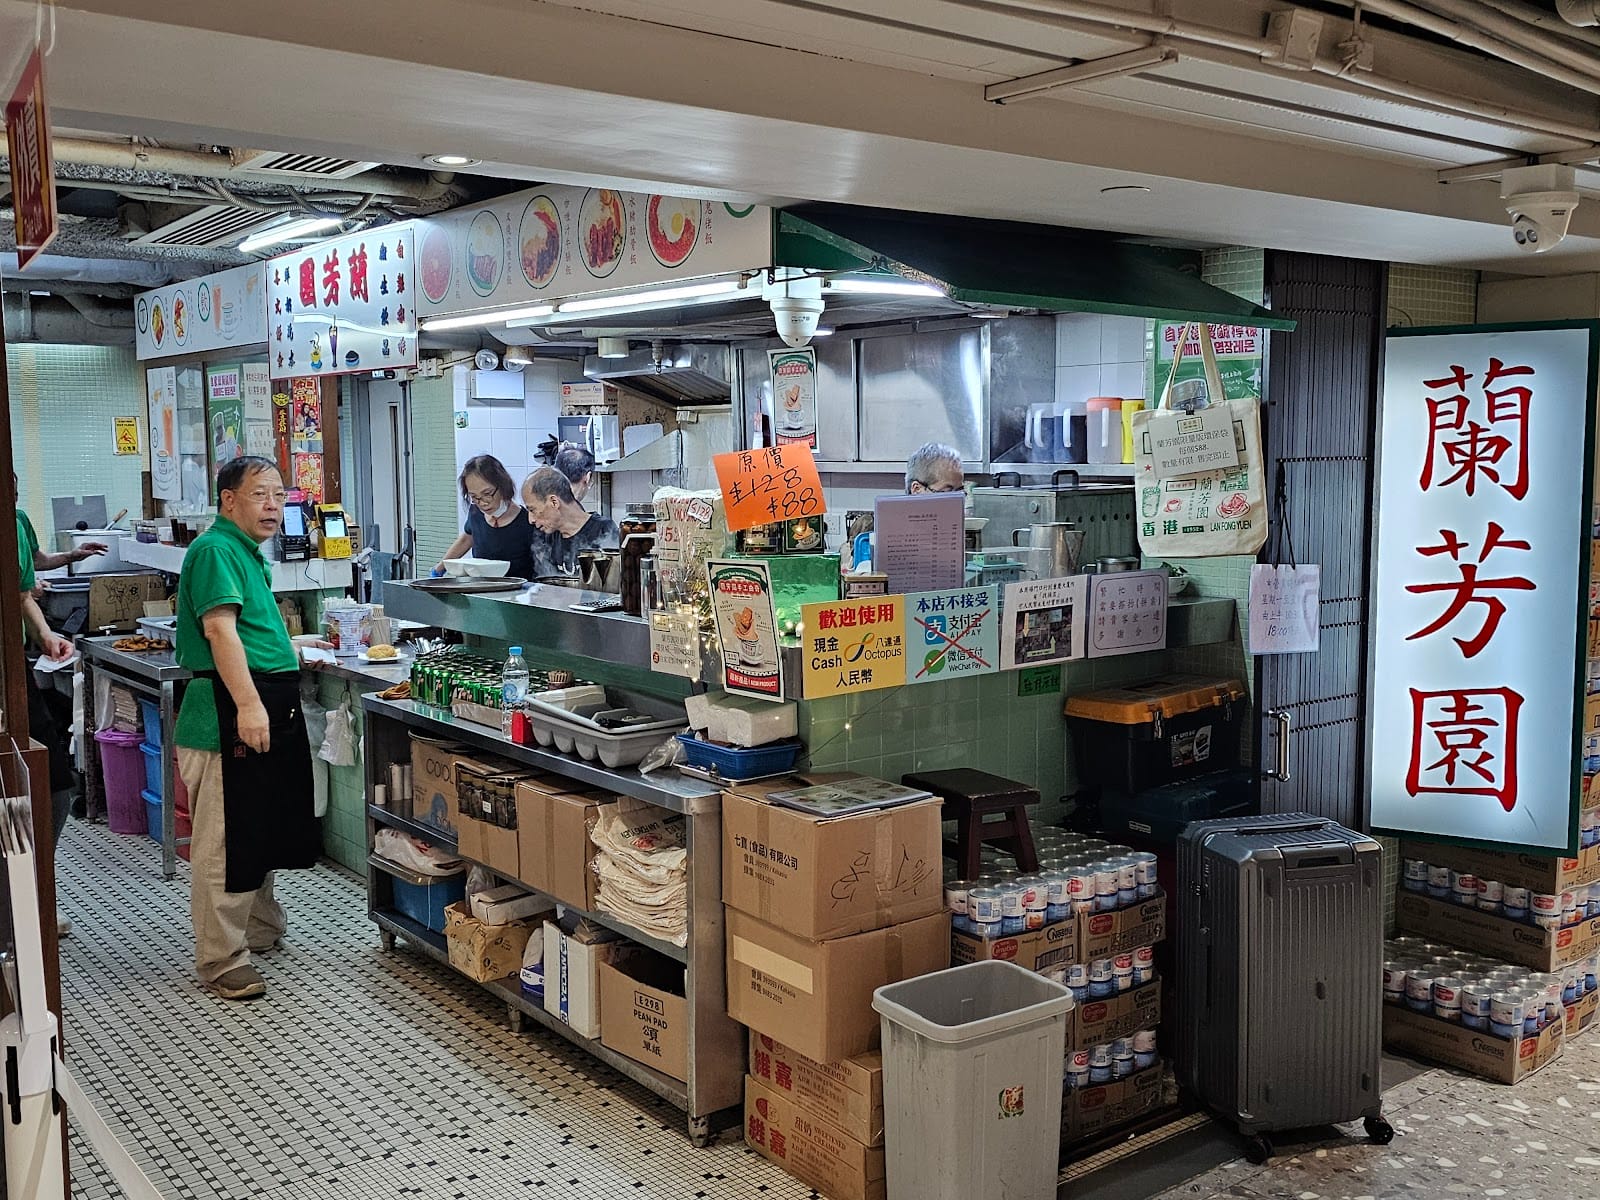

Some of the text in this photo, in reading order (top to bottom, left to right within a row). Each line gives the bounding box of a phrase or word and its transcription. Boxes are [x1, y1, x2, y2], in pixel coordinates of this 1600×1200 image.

[1214, 340, 1255, 354] 염장레몬
[738, 448, 784, 474] 原價
[729, 468, 802, 503] $128
[767, 488, 817, 518] $88
[1143, 519, 1179, 537] 香港
[1211, 520, 1252, 532] LAN FONG YUEN
[1404, 357, 1537, 812] 蘭芳園
[916, 592, 989, 613] 本店不接受
[818, 603, 894, 630] 歡迎使用
[948, 613, 982, 631] 支付宝
[814, 636, 839, 653] 現金
[811, 655, 842, 670] Cash
[864, 648, 902, 661] Octopus
[947, 646, 983, 662] 微信支付
[948, 661, 981, 672] WeChat Pay
[836, 668, 872, 688] 人民幣
[634, 1009, 668, 1029] PEAN PAD
